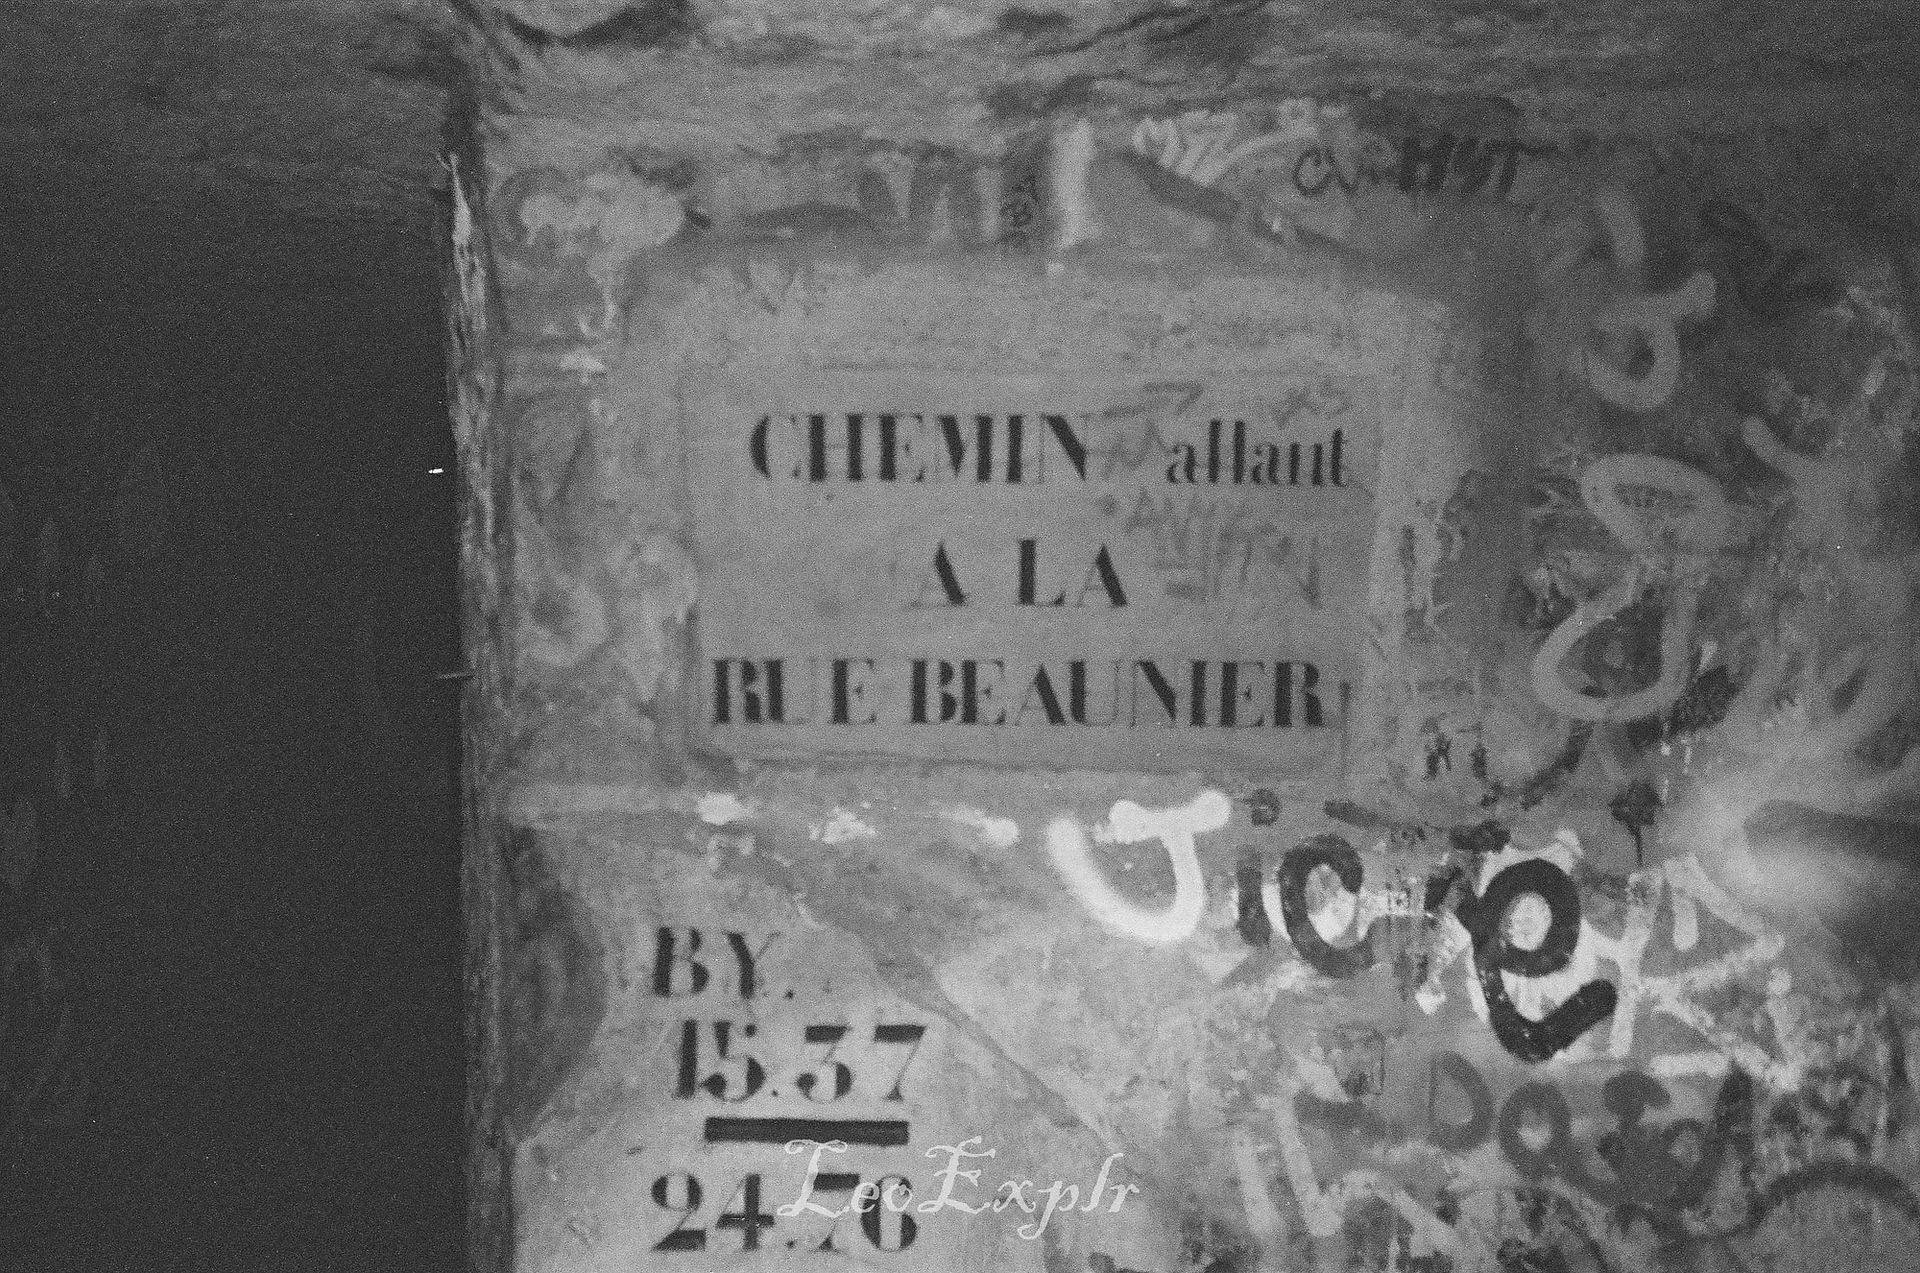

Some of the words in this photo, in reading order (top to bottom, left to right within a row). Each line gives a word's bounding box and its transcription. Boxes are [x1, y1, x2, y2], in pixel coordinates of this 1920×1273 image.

[749, 412, 1090, 485] CHEMIN
[1164, 419, 1347, 487] allant
[904, 540, 967, 607] A
[1014, 537, 1128, 607] LA
[711, 656, 876, 726] RUE
[908, 655, 1326, 728] BEAUNIER
[671, 1019, 927, 1102] 15.37
